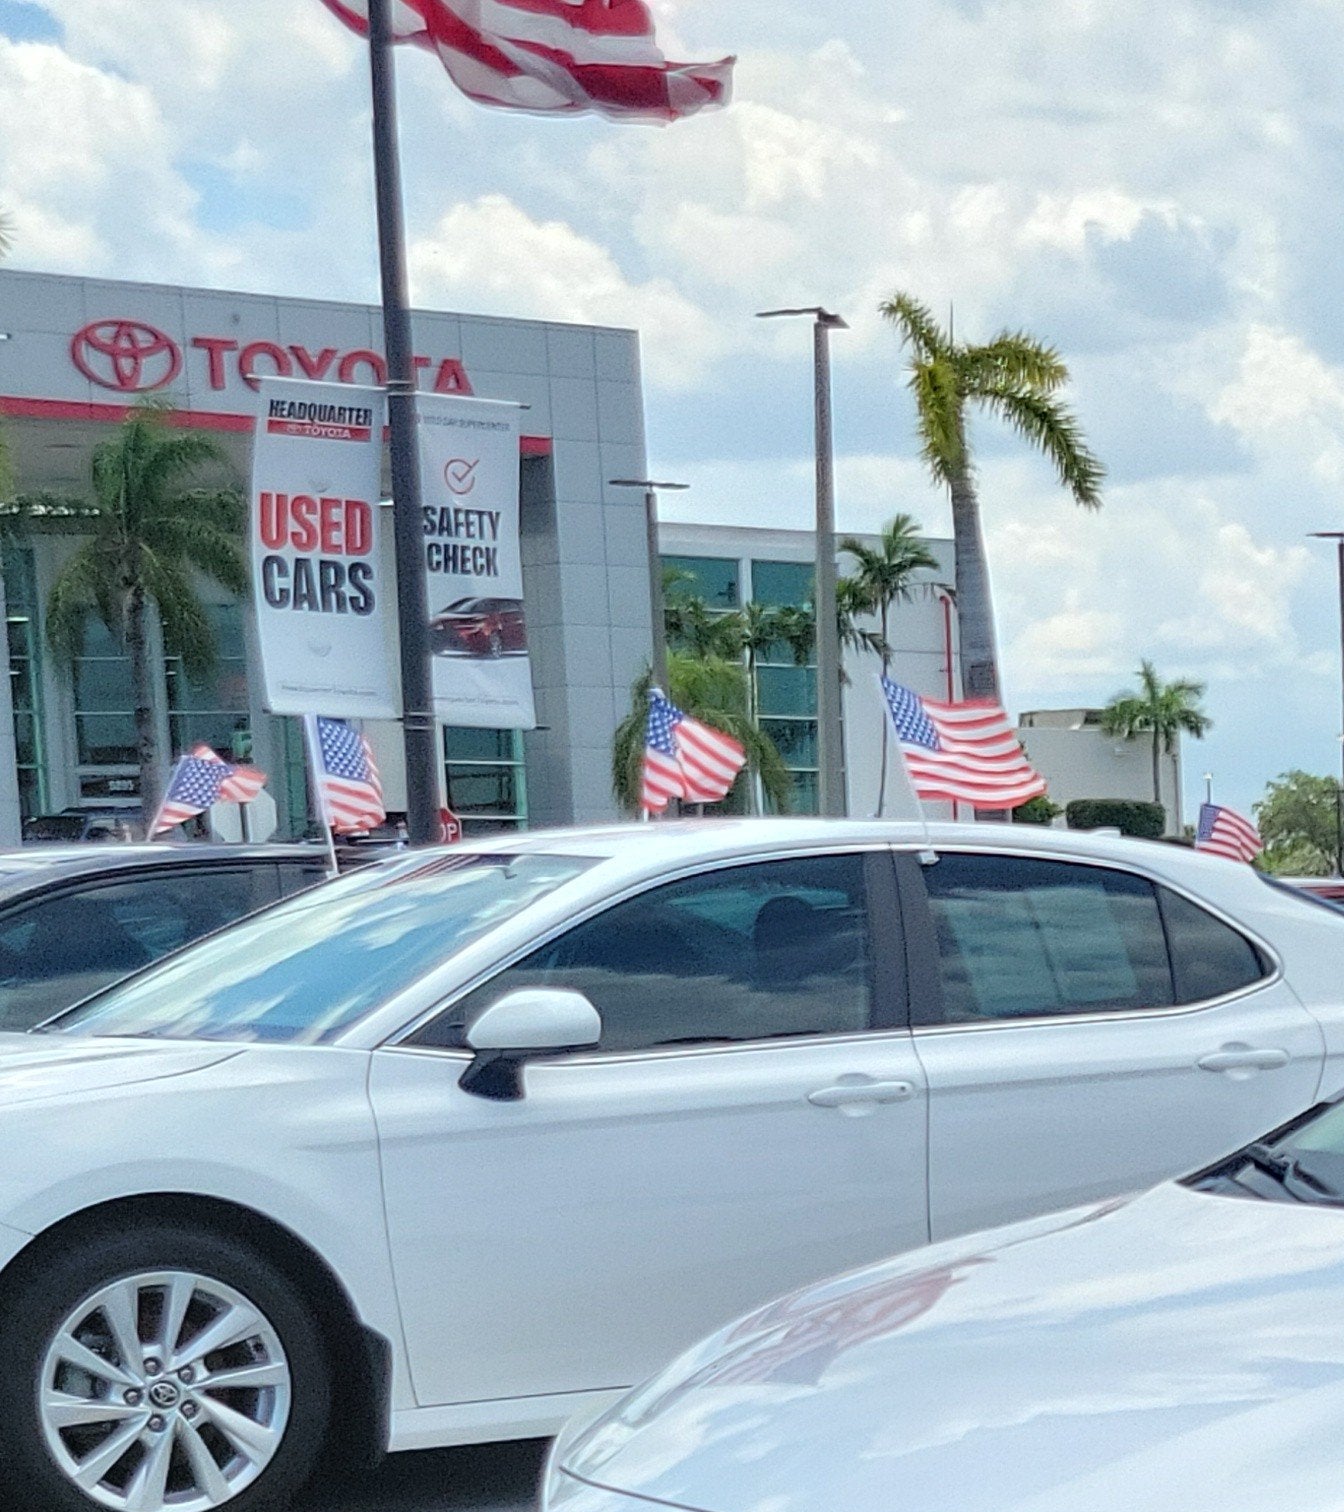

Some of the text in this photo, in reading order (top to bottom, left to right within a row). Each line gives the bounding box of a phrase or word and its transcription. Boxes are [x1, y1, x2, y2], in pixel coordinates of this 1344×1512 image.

[268, 399, 373, 426] HEADQUARTER
[304, 424, 351, 439] TOYOTA
[259, 491, 373, 557] USED
[423, 505, 501, 542] SAFETY
[426, 542, 499, 577] CHECK
[262, 554, 376, 616] CARS
